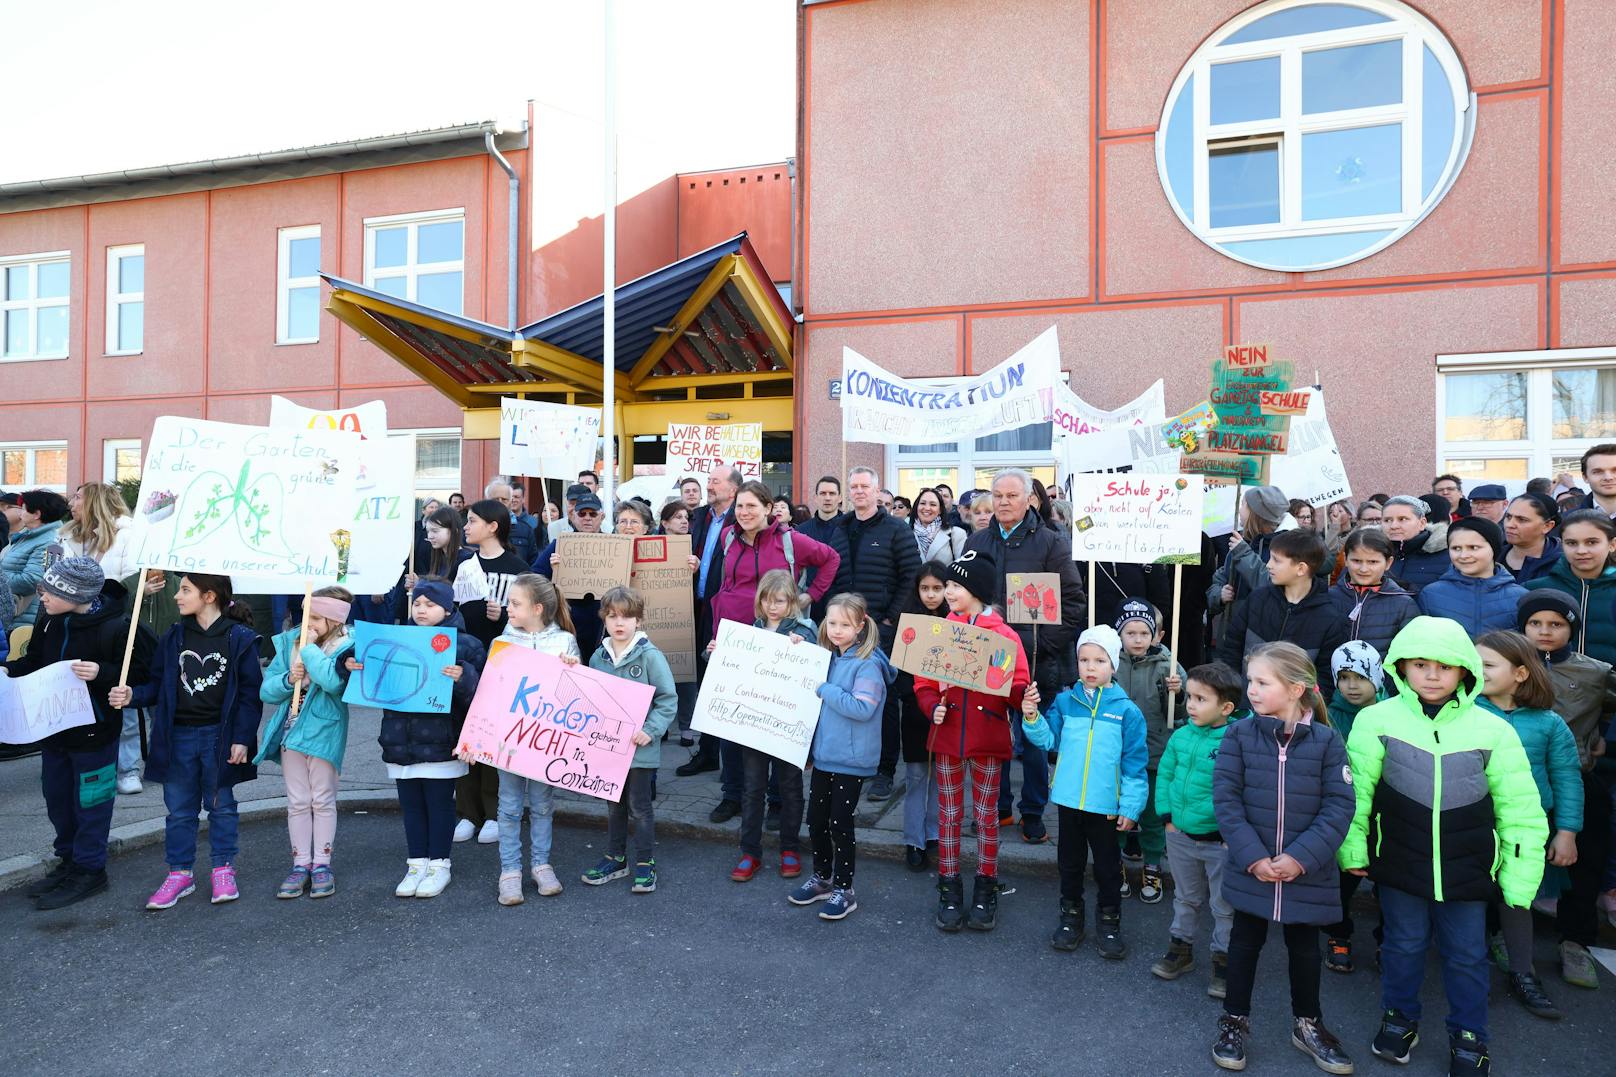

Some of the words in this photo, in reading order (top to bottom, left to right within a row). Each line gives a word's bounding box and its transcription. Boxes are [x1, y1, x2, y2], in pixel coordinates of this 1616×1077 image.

[1228, 346, 1267, 365] NEIN
[1242, 368, 1264, 377] ZUR
[847, 362, 1025, 409] KONZENTRATION
[672, 425, 701, 441] WIR
[1208, 430, 1285, 452] PLATZMANGEL
[168, 427, 228, 450] Der
[244, 432, 331, 459] Garten
[669, 440, 721, 457] GERNE
[171, 454, 197, 472] die
[684, 457, 760, 478] SPIELPTZ!
[1104, 479, 1150, 497] Schule
[354, 496, 400, 520] ATZ
[1110, 502, 1131, 513] nicht
[1139, 502, 1153, 518] auf
[1157, 503, 1193, 516] Kosten
[137, 535, 208, 571] Lunge
[222, 559, 278, 571] unserer
[562, 541, 621, 557] GERECHTE
[637, 541, 662, 557] NEIN
[1083, 532, 1186, 561] Grünflächen
[562, 558, 615, 569] VERTEILUNG
[723, 628, 765, 654] Kinder
[754, 662, 792, 681] Container
[509, 676, 599, 733] Kinder
[504, 717, 583, 756] NICHT
[572, 747, 585, 761] in
[545, 757, 619, 796] Container
